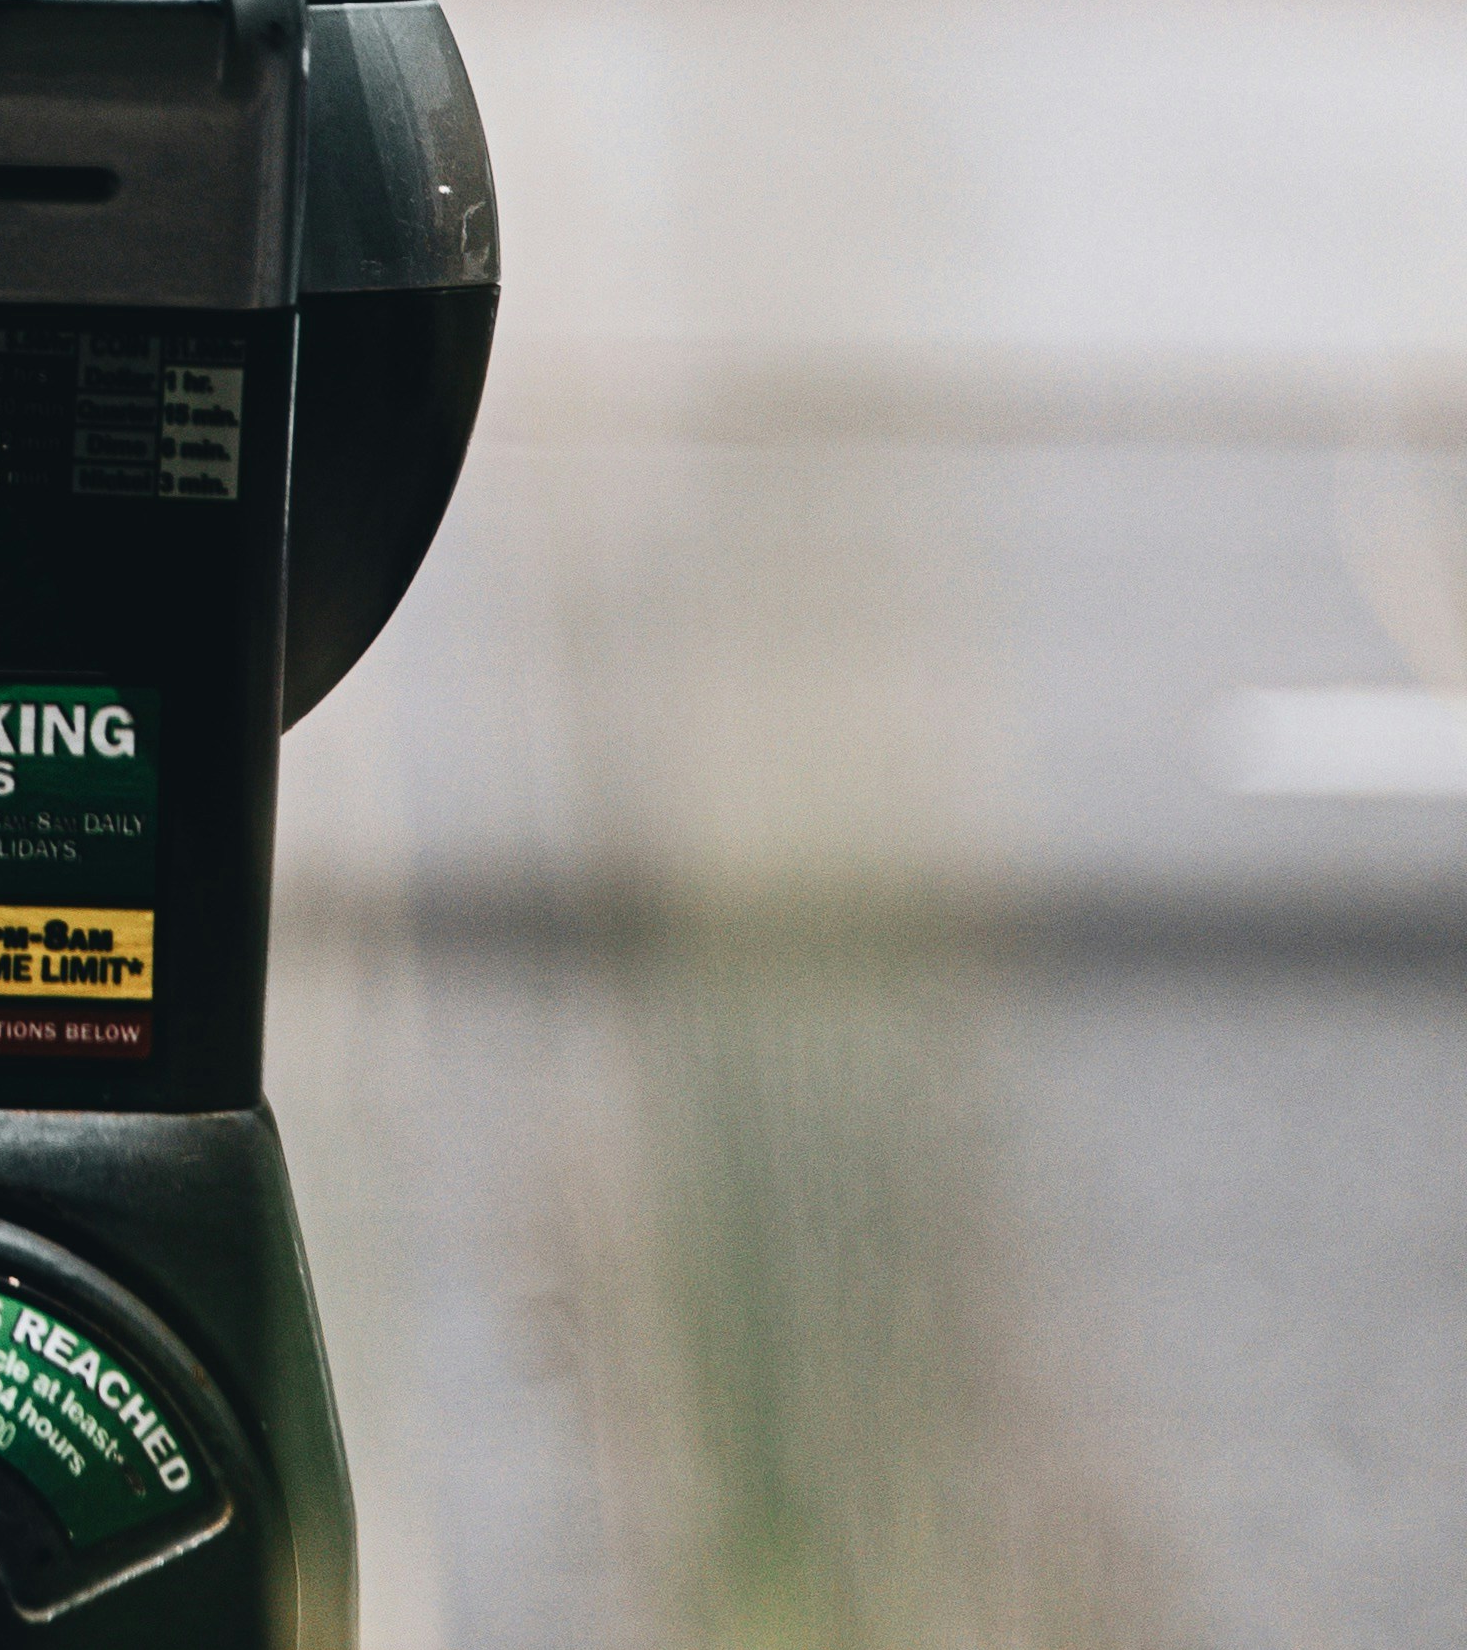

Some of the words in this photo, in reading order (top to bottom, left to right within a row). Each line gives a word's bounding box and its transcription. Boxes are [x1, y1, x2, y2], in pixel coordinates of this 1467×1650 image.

[83, 812, 147, 837] DAILY
[65, 1022, 141, 1045] BELOW
[12, 1307, 192, 1493] REACHED
[18, 1397, 87, 1477] hours
[32, 1371, 62, 1403] at
[60, 1390, 123, 1465] least
